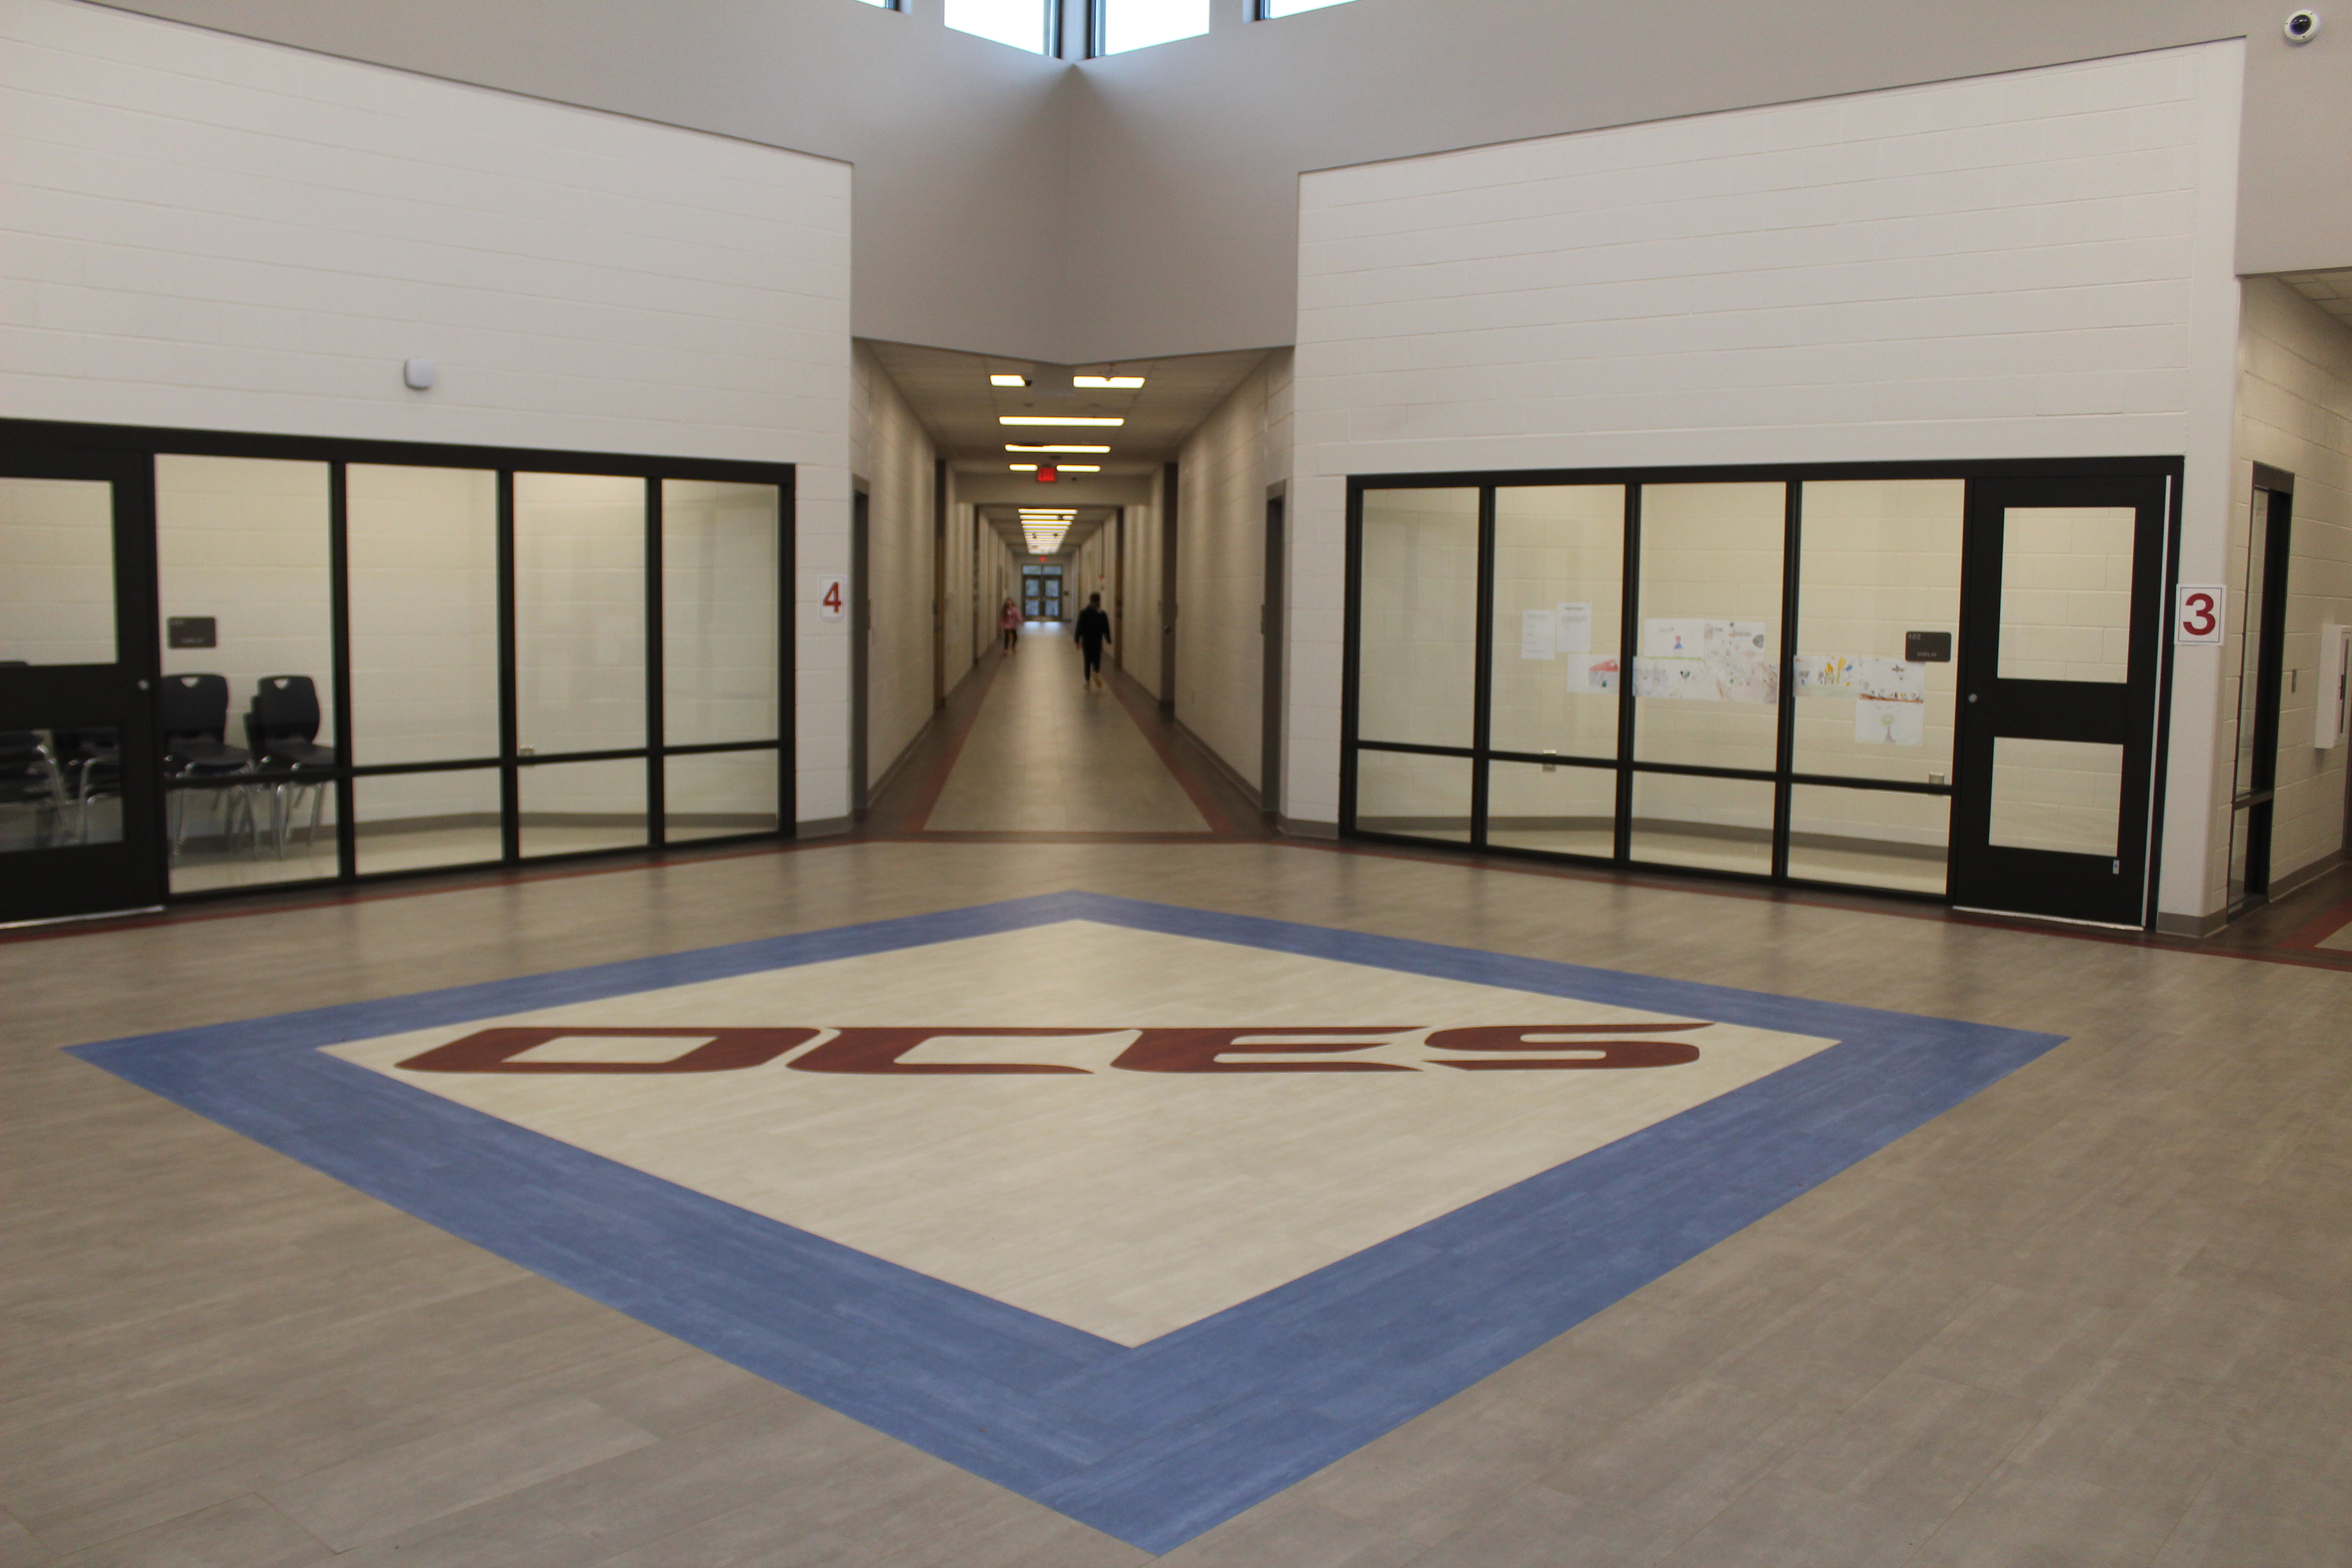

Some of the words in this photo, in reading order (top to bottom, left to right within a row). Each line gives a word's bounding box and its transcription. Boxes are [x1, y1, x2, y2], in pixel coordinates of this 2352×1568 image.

[823, 581, 842, 613] 4
[2183, 593, 2216, 636] 3
[394, 1022, 1715, 1074] OCES
